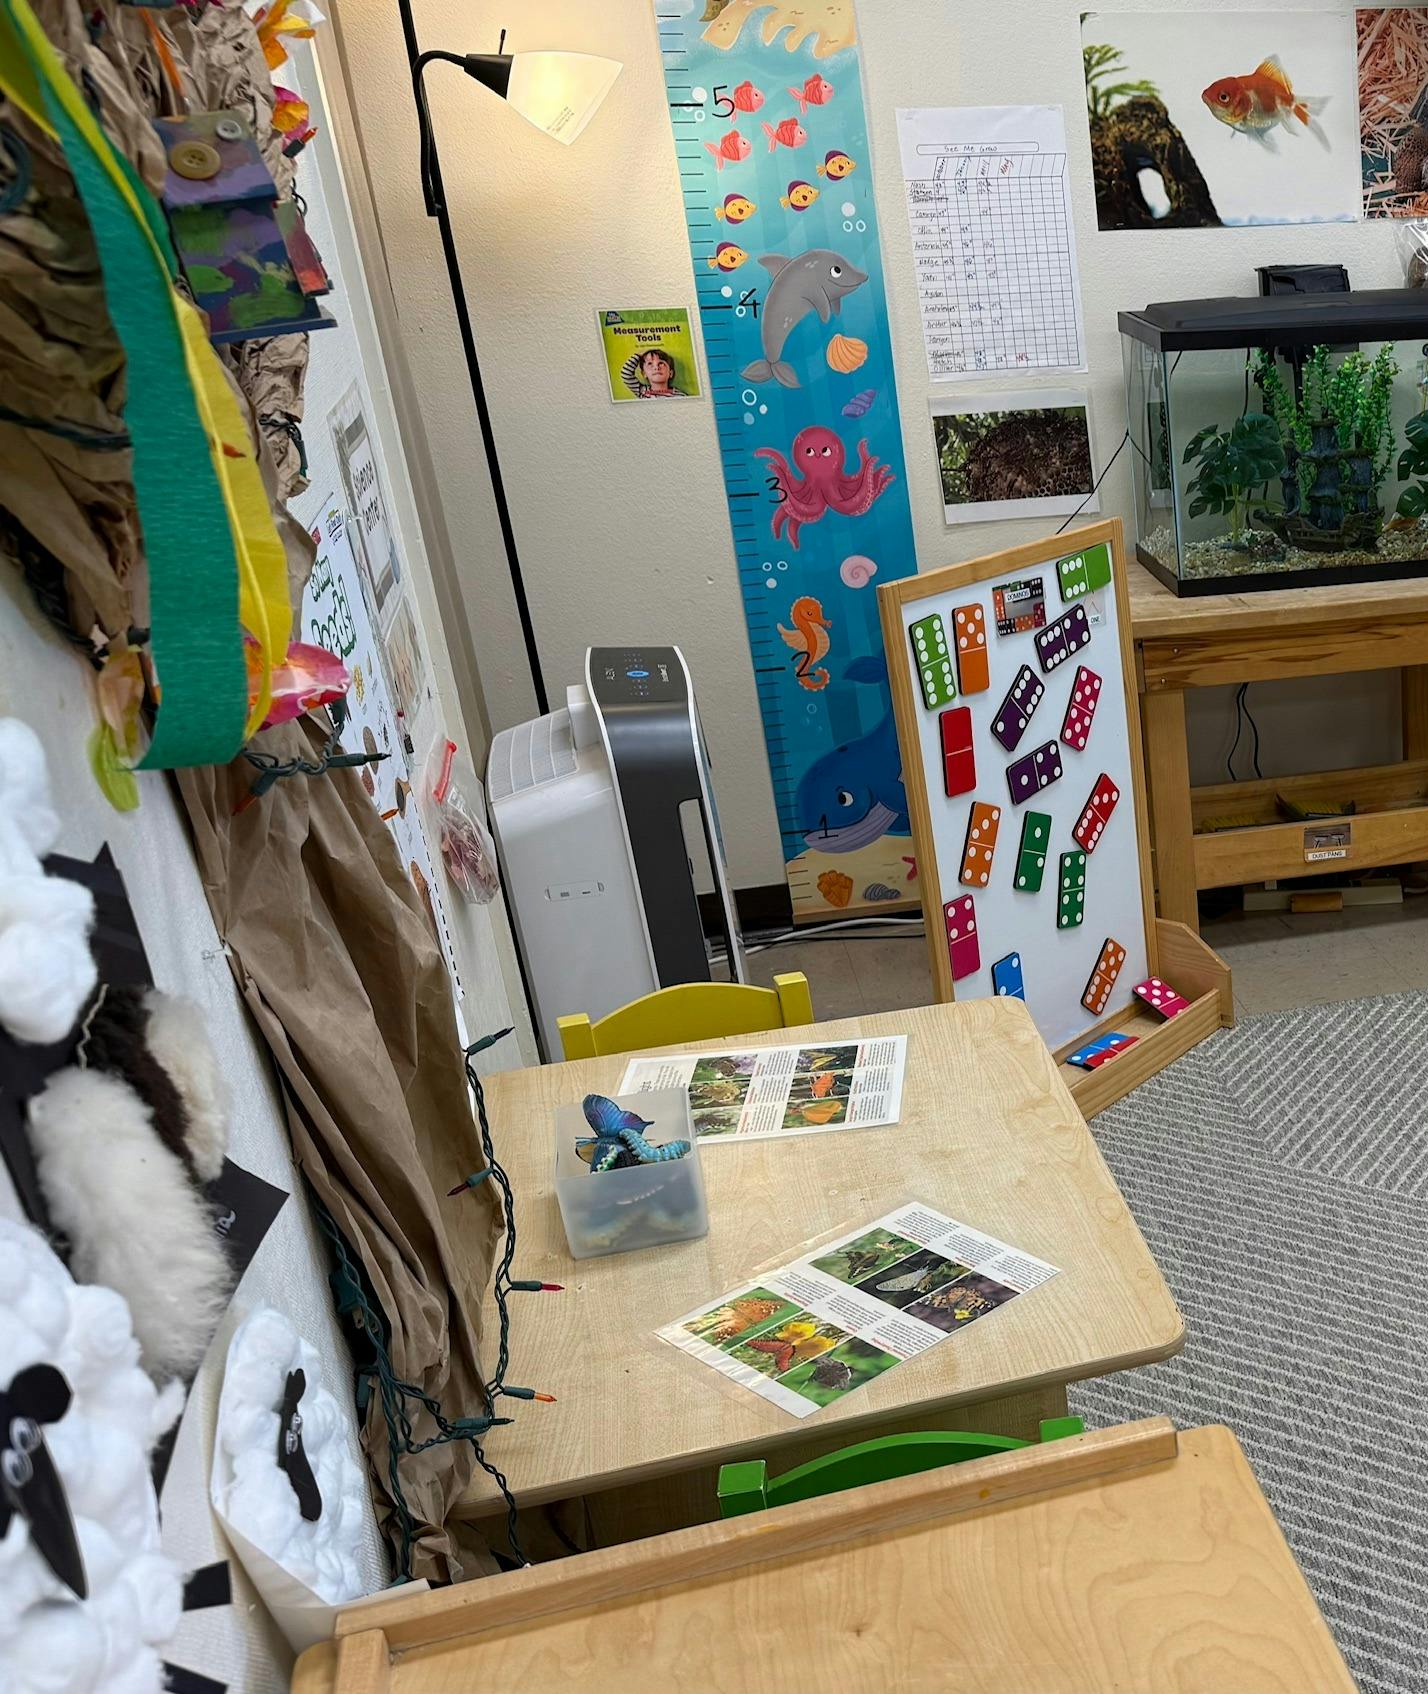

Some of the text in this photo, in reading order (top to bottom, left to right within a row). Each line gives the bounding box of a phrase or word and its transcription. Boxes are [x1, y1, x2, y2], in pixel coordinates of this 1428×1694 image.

[712, 85, 735, 118] 5
[738, 287, 761, 319] 4
[613, 325, 681, 335] Measurement
[636, 334, 661, 342] Tools
[768, 477, 788, 504] 3
[1007, 590, 1030, 601] DOMINOS
[1091, 616, 1100, 624] ONE
[791, 651, 815, 678] 2
[819, 814, 839, 840] 1
